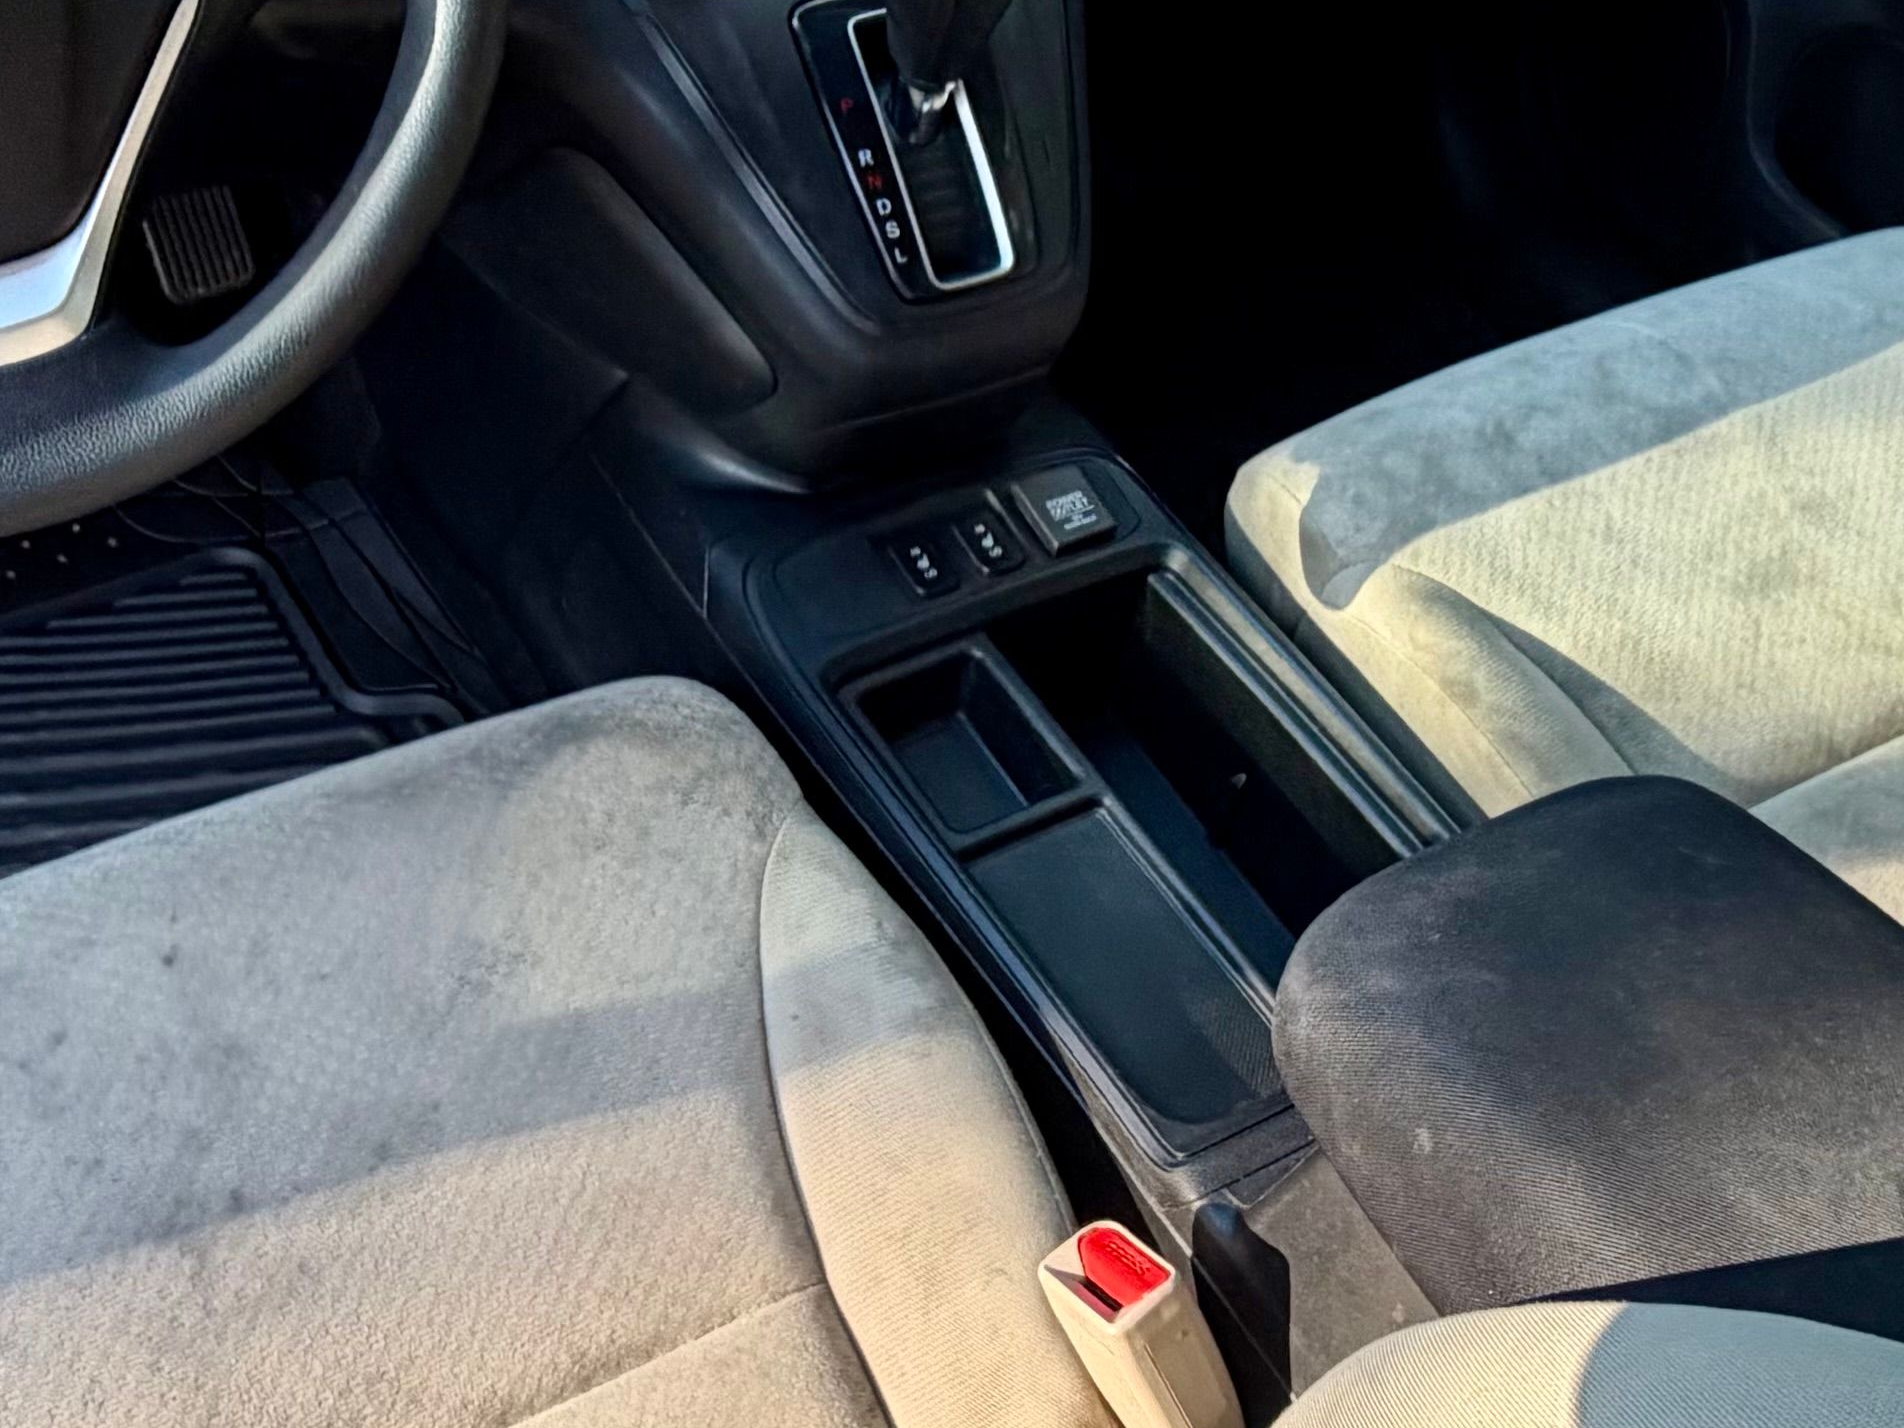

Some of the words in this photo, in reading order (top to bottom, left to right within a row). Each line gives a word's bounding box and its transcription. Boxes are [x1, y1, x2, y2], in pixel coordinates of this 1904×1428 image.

[840, 97, 854, 114] P
[858, 148, 874, 168] R
[867, 174, 883, 190] N
[876, 198, 892, 217] D
[885, 220, 901, 239] S
[894, 247, 908, 265] L
